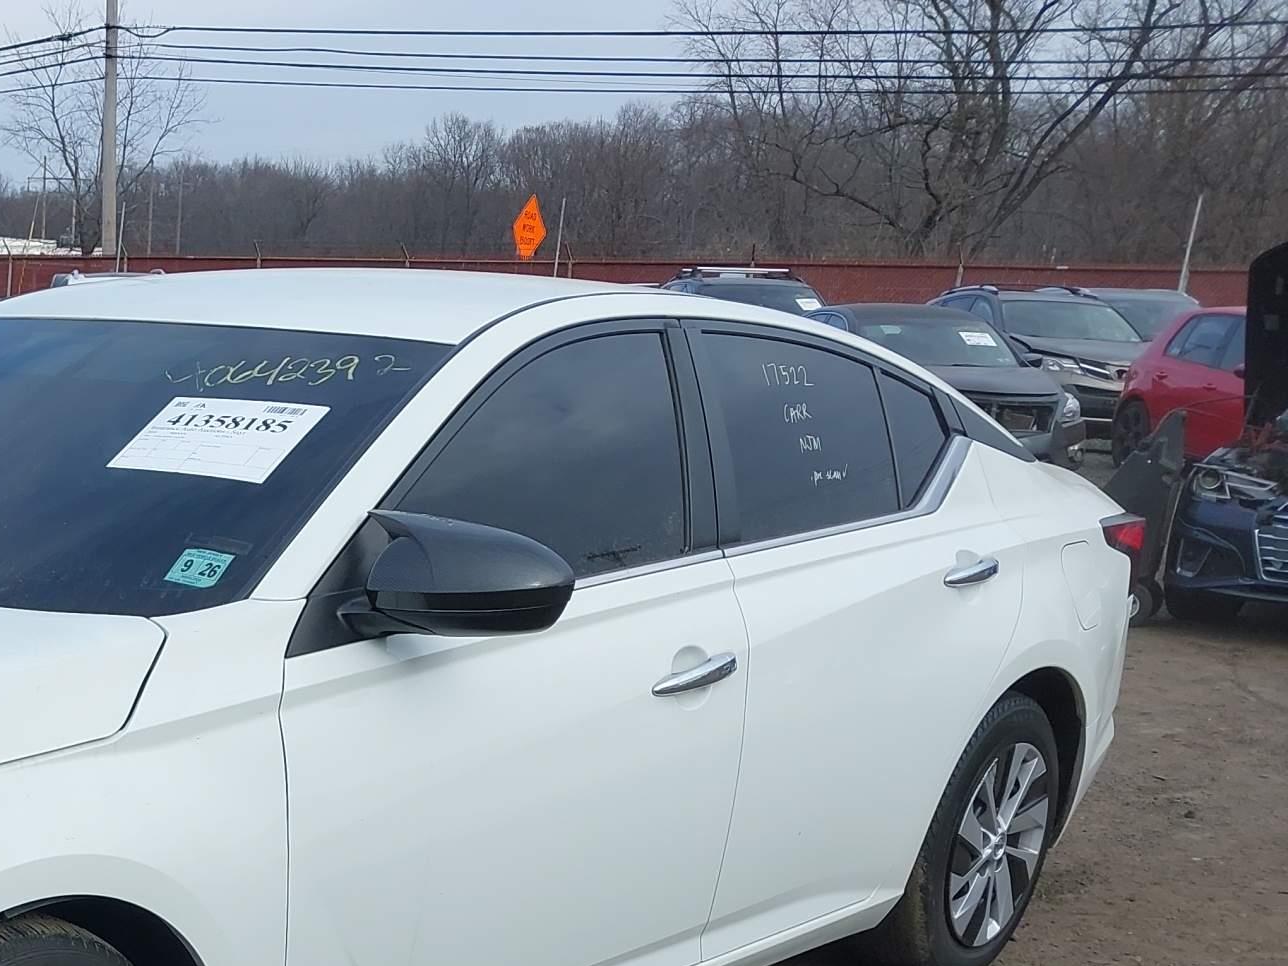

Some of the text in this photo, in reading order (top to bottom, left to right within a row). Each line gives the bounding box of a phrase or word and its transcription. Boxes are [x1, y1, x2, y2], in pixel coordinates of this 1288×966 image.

[761, 362, 815, 386] 17522
[166, 411, 294, 434] 41358185
[784, 402, 813, 424] CARR
[180, 559, 221, 578] 9 26
